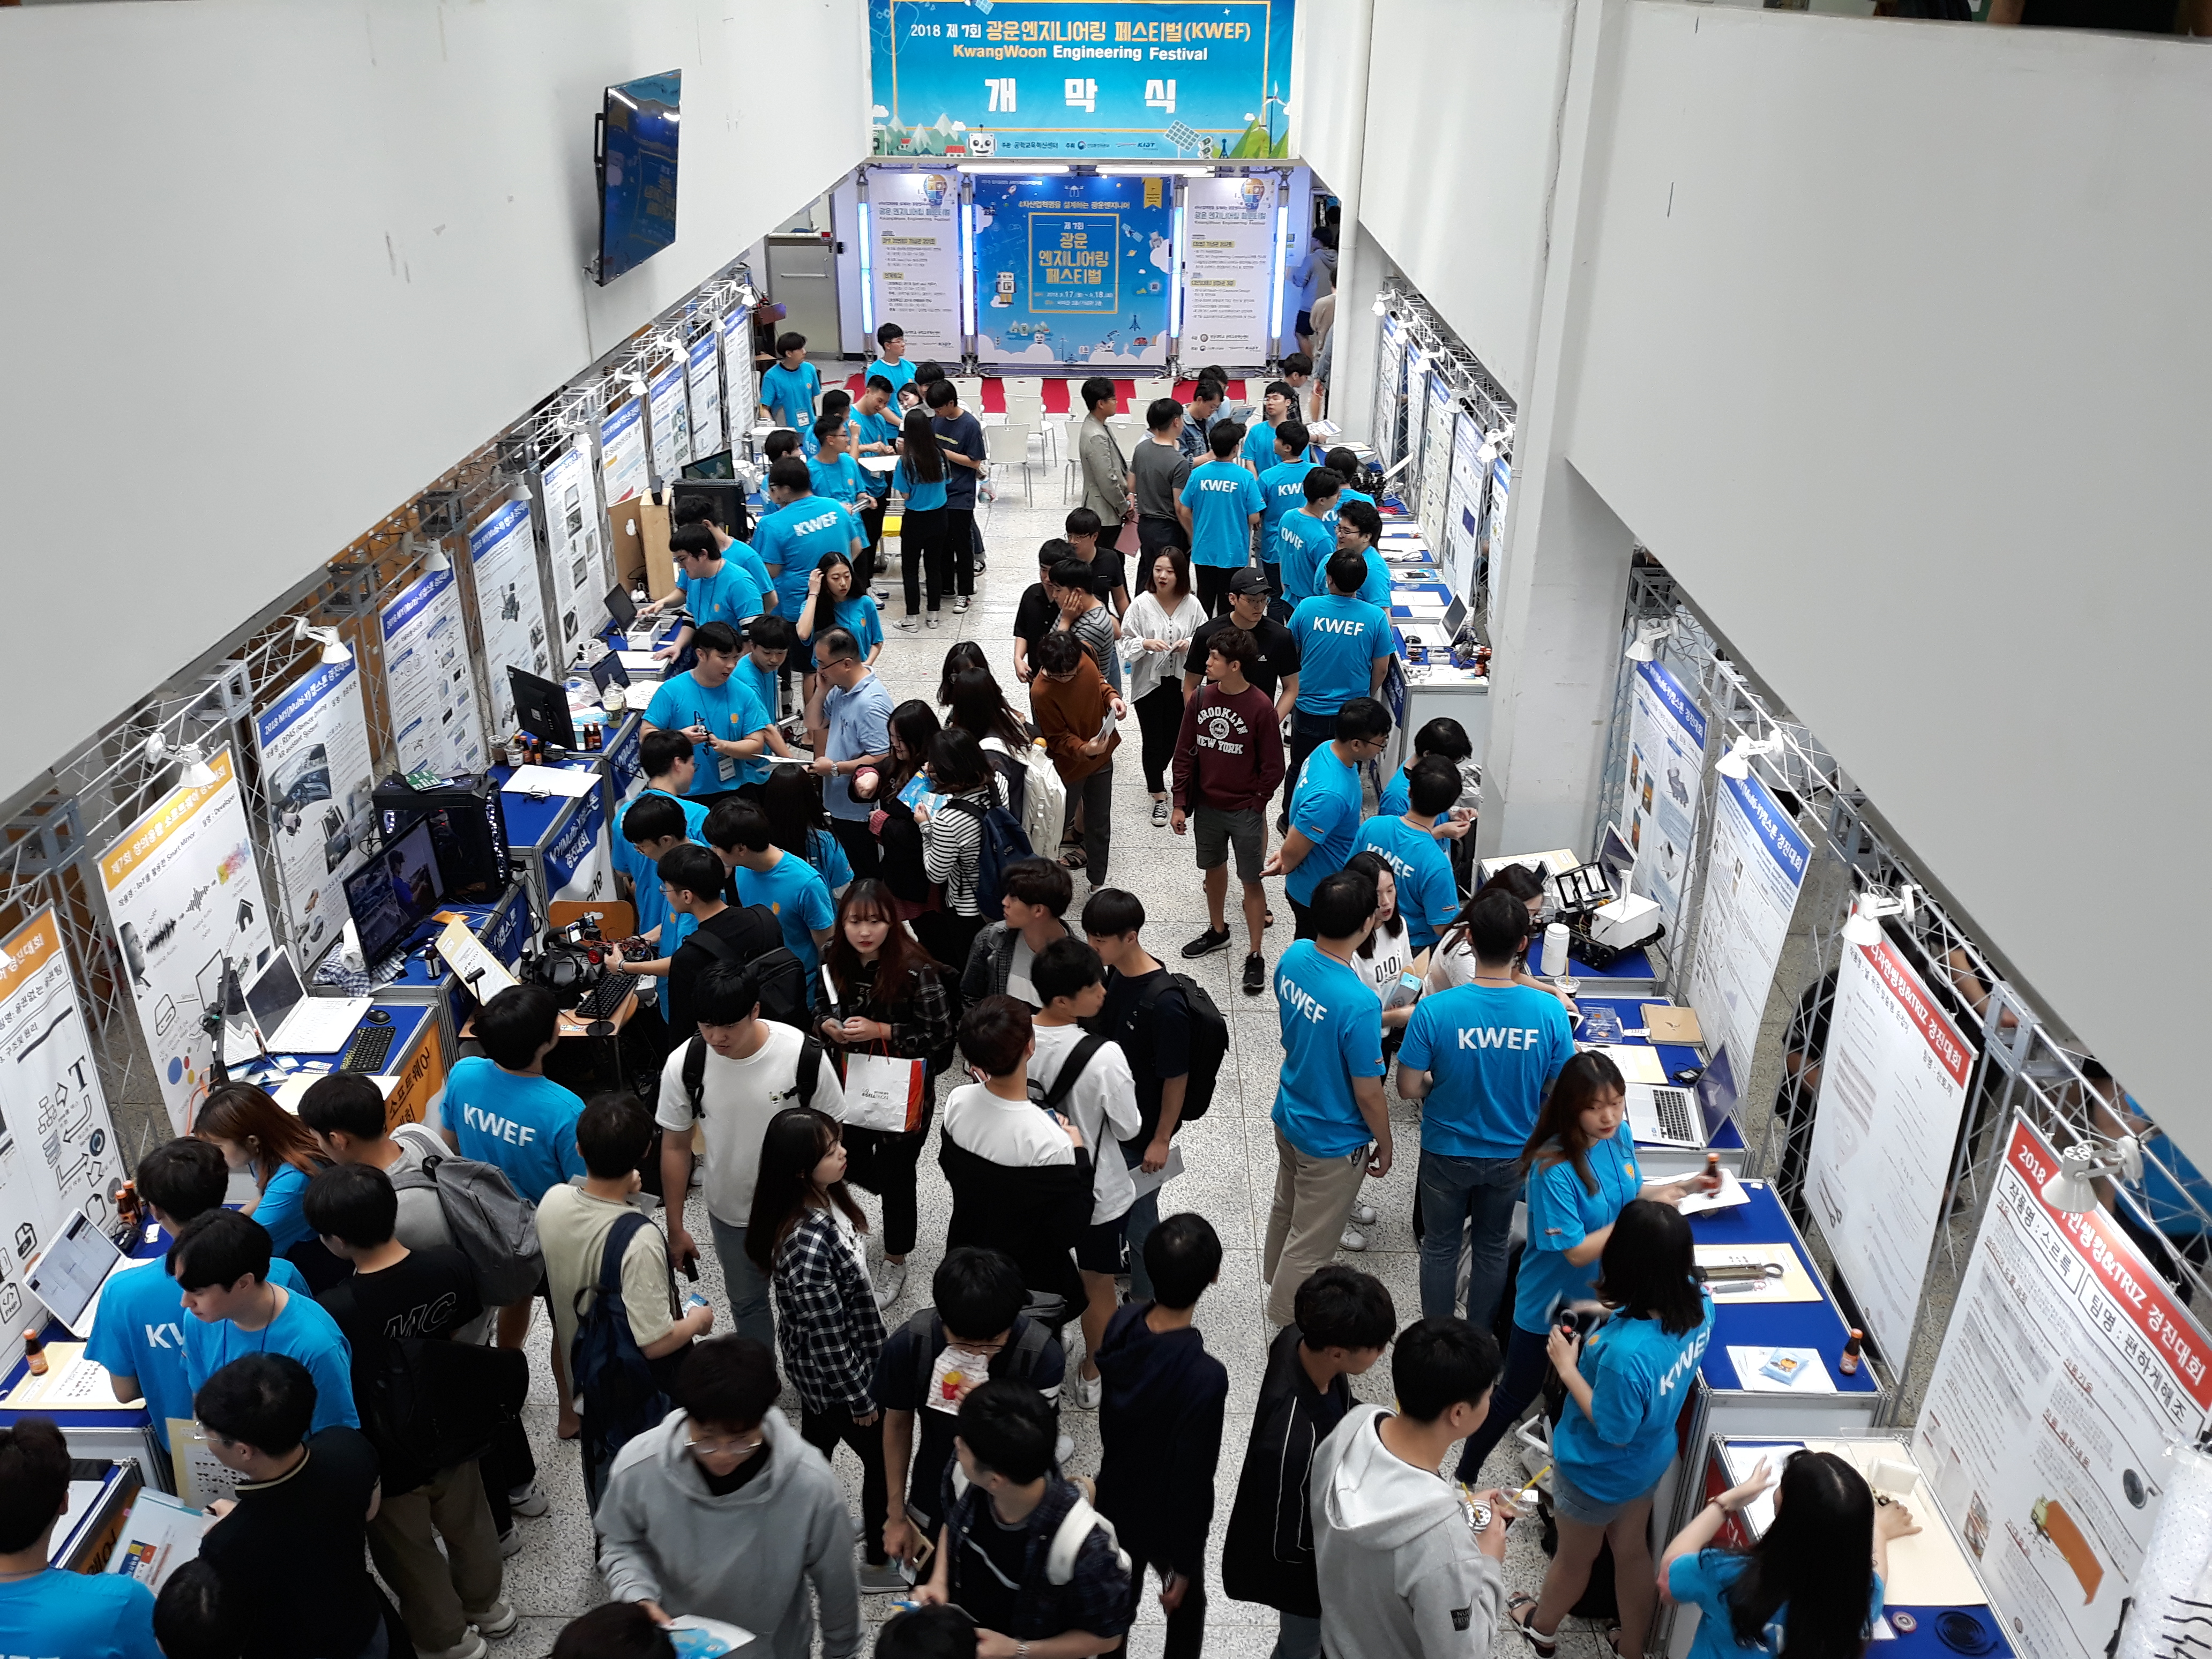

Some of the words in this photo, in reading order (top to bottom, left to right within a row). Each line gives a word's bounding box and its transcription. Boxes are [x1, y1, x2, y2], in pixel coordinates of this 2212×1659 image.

[910, 24, 941, 37] 2018
[946, 23, 958, 38] 제
[961, 23, 982, 38] 7회
[985, 20, 1106, 41] 광운엔지니어링
[1114, 20, 1251, 42] 페스티벌(KWEF)
[953, 44, 1047, 60] KwangWoon
[1053, 45, 1142, 61] Engineering
[1149, 47, 1208, 61] Festival
[984, 78, 1017, 113] 개
[1064, 77, 1097, 113] 막
[1145, 78, 1176, 114] 식
[1059, 233, 1088, 249] 광운
[1038, 250, 1109, 267] 엔지니어링
[1045, 268, 1102, 284] 페스티벌
[1200, 479, 1238, 494] KWEF
[1278, 483, 1304, 496] KW
[793, 511, 838, 536] KWEF
[1313, 616, 1365, 636] KWEF
[1198, 706, 1248, 735] BROOKLYN
[1197, 733, 1216, 749] NEW
[1218, 742, 1244, 754] YORK
[1777, 833, 1804, 872] 경진대회
[1280, 975, 1327, 1024] KWEF
[1457, 1026, 1540, 1051] KWEF
[1929, 1018, 1962, 1073] 경진대회
[390, 1046, 430, 1121] 소프트웨어
[464, 1103, 536, 1147] KWEF
[2009, 1181, 2036, 1228] 작품명
[2017, 1144, 2048, 1185] 2018
[2060, 1210, 2148, 1310] 인씽킹&TRIZ
[2148, 1302, 2207, 1387] 경진대회
[1660, 1332, 1710, 1396] KWE
[2090, 1294, 2117, 1336] 팀명
[2124, 1336, 2188, 1424] 편하게해조
